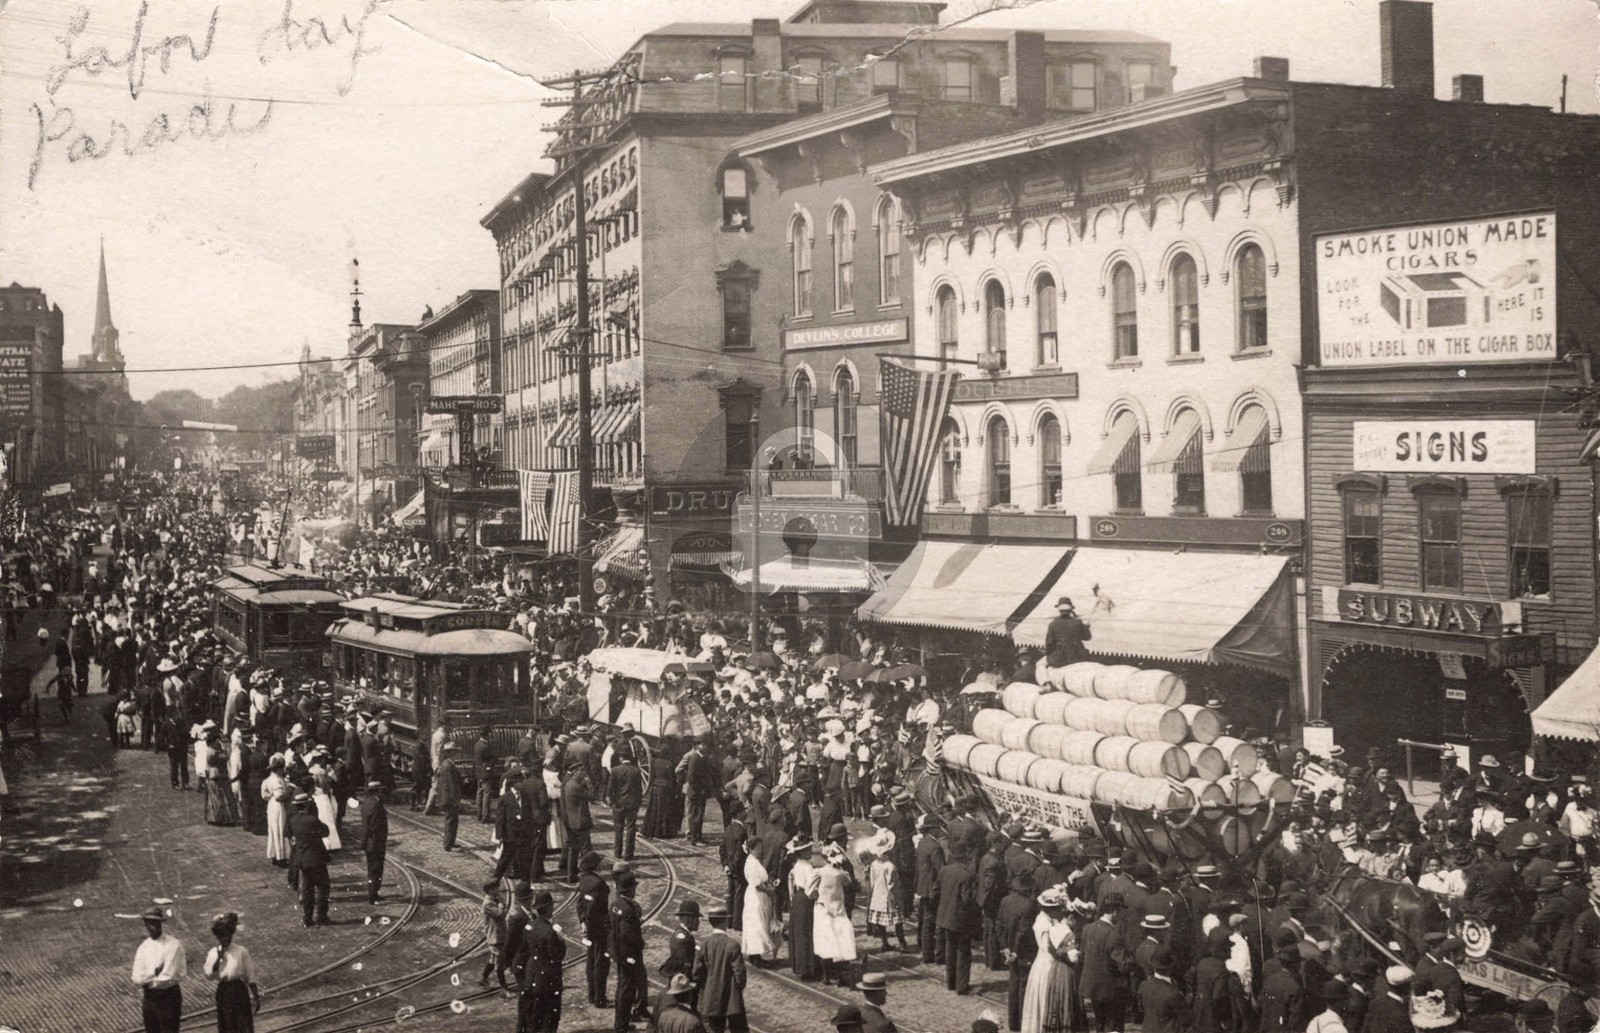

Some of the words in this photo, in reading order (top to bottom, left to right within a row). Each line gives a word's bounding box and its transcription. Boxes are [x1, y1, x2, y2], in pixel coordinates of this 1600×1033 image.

[1325, 234, 1396, 258] SMOKE
[1408, 226, 1469, 250] UNION
[1484, 217, 1548, 242] MADE
[1386, 249, 1478, 271] CIGARS
[1327, 277, 1359, 293] LOOK
[1339, 295, 1360, 310] FOR
[1497, 293, 1525, 312] HERE
[1533, 287, 1545, 301] IT
[1531, 305, 1544, 322] IS
[844, 323, 899, 339] COLLEGE
[1323, 341, 1363, 359] UNION
[1370, 340, 1407, 357] LABEL
[1417, 338, 1436, 355] ON
[1445, 337, 1471, 354] THE
[1478, 335, 1519, 353] CIGAR
[1526, 332, 1554, 351] BOX
[430, 400, 458, 410] MAHE
[1396, 431, 1488, 462] SIGNS
[1099, 524, 1114, 532] 208
[1270, 527, 1287, 536] 208
[1347, 594, 1493, 632] SUBWAY
[1042, 800, 1062, 815] USED
[1065, 804, 1085, 820] THE
